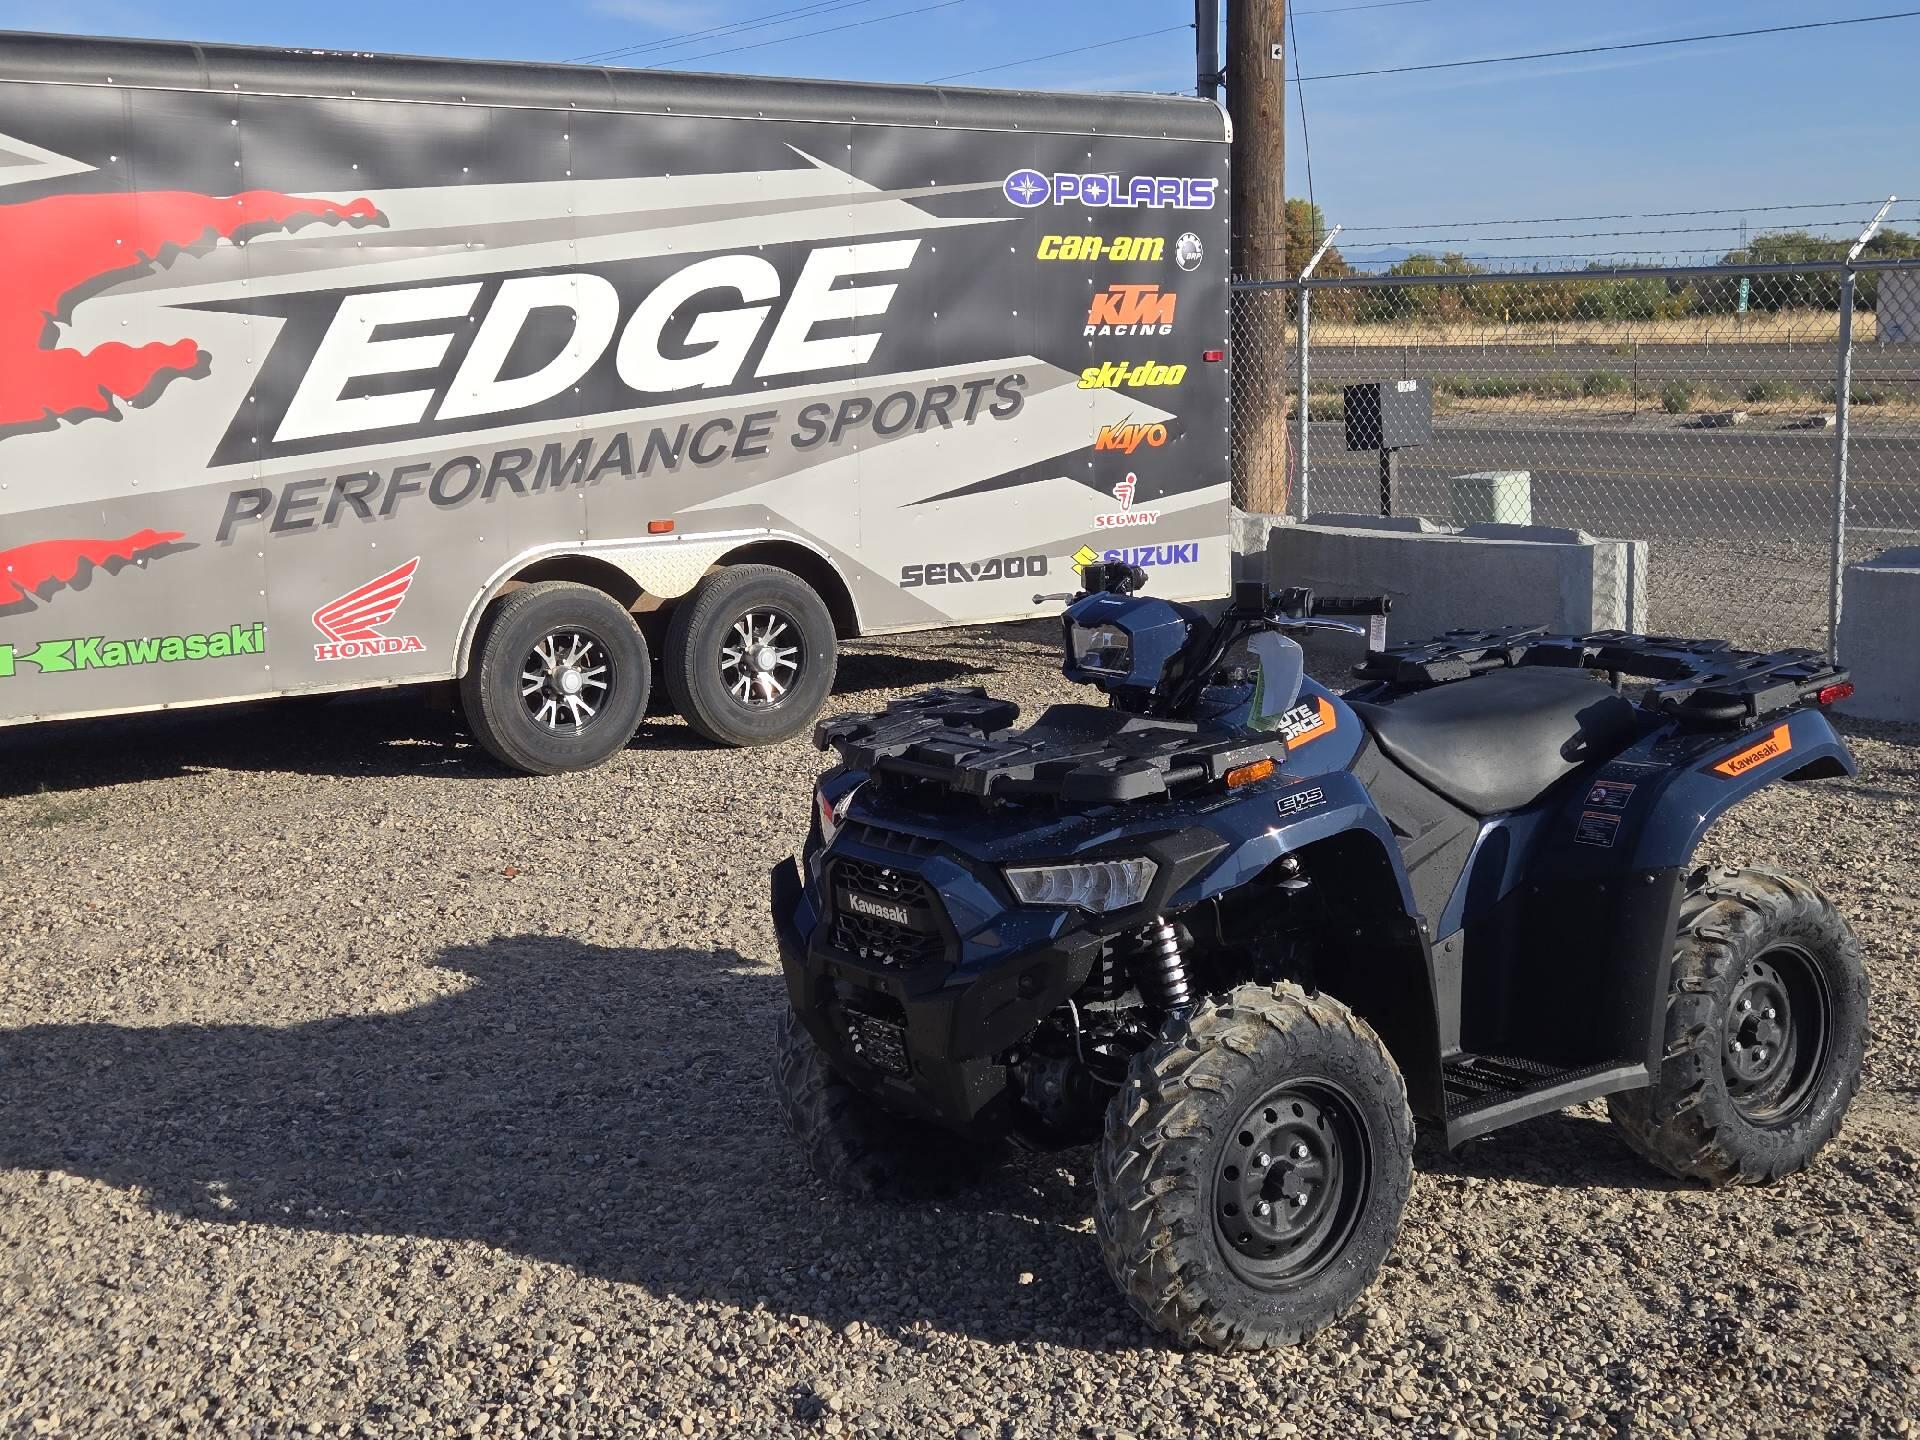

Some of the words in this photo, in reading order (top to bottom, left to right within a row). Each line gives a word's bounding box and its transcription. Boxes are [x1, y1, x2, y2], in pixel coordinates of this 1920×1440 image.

[1053, 172, 1215, 210] POLARIS
[1037, 235, 1164, 261] can-am
[1087, 284, 1176, 325] KTM
[272, 239, 921, 443] EDGE
[1083, 324, 1173, 336] RACING
[1077, 361, 1187, 389] ski-doo
[1094, 418, 1167, 454] KAYO
[215, 409, 780, 547] PERFORMANCE
[790, 374, 1030, 452] SPORTS
[1095, 511, 1159, 527] SEGWAY
[75, 622, 264, 670] Kawasaki
[314, 636, 425, 661] HONDA
[1278, 704, 1313, 729] UTE
[1727, 742, 1780, 773] Kawasaki
[849, 893, 908, 925] Kawasaki
